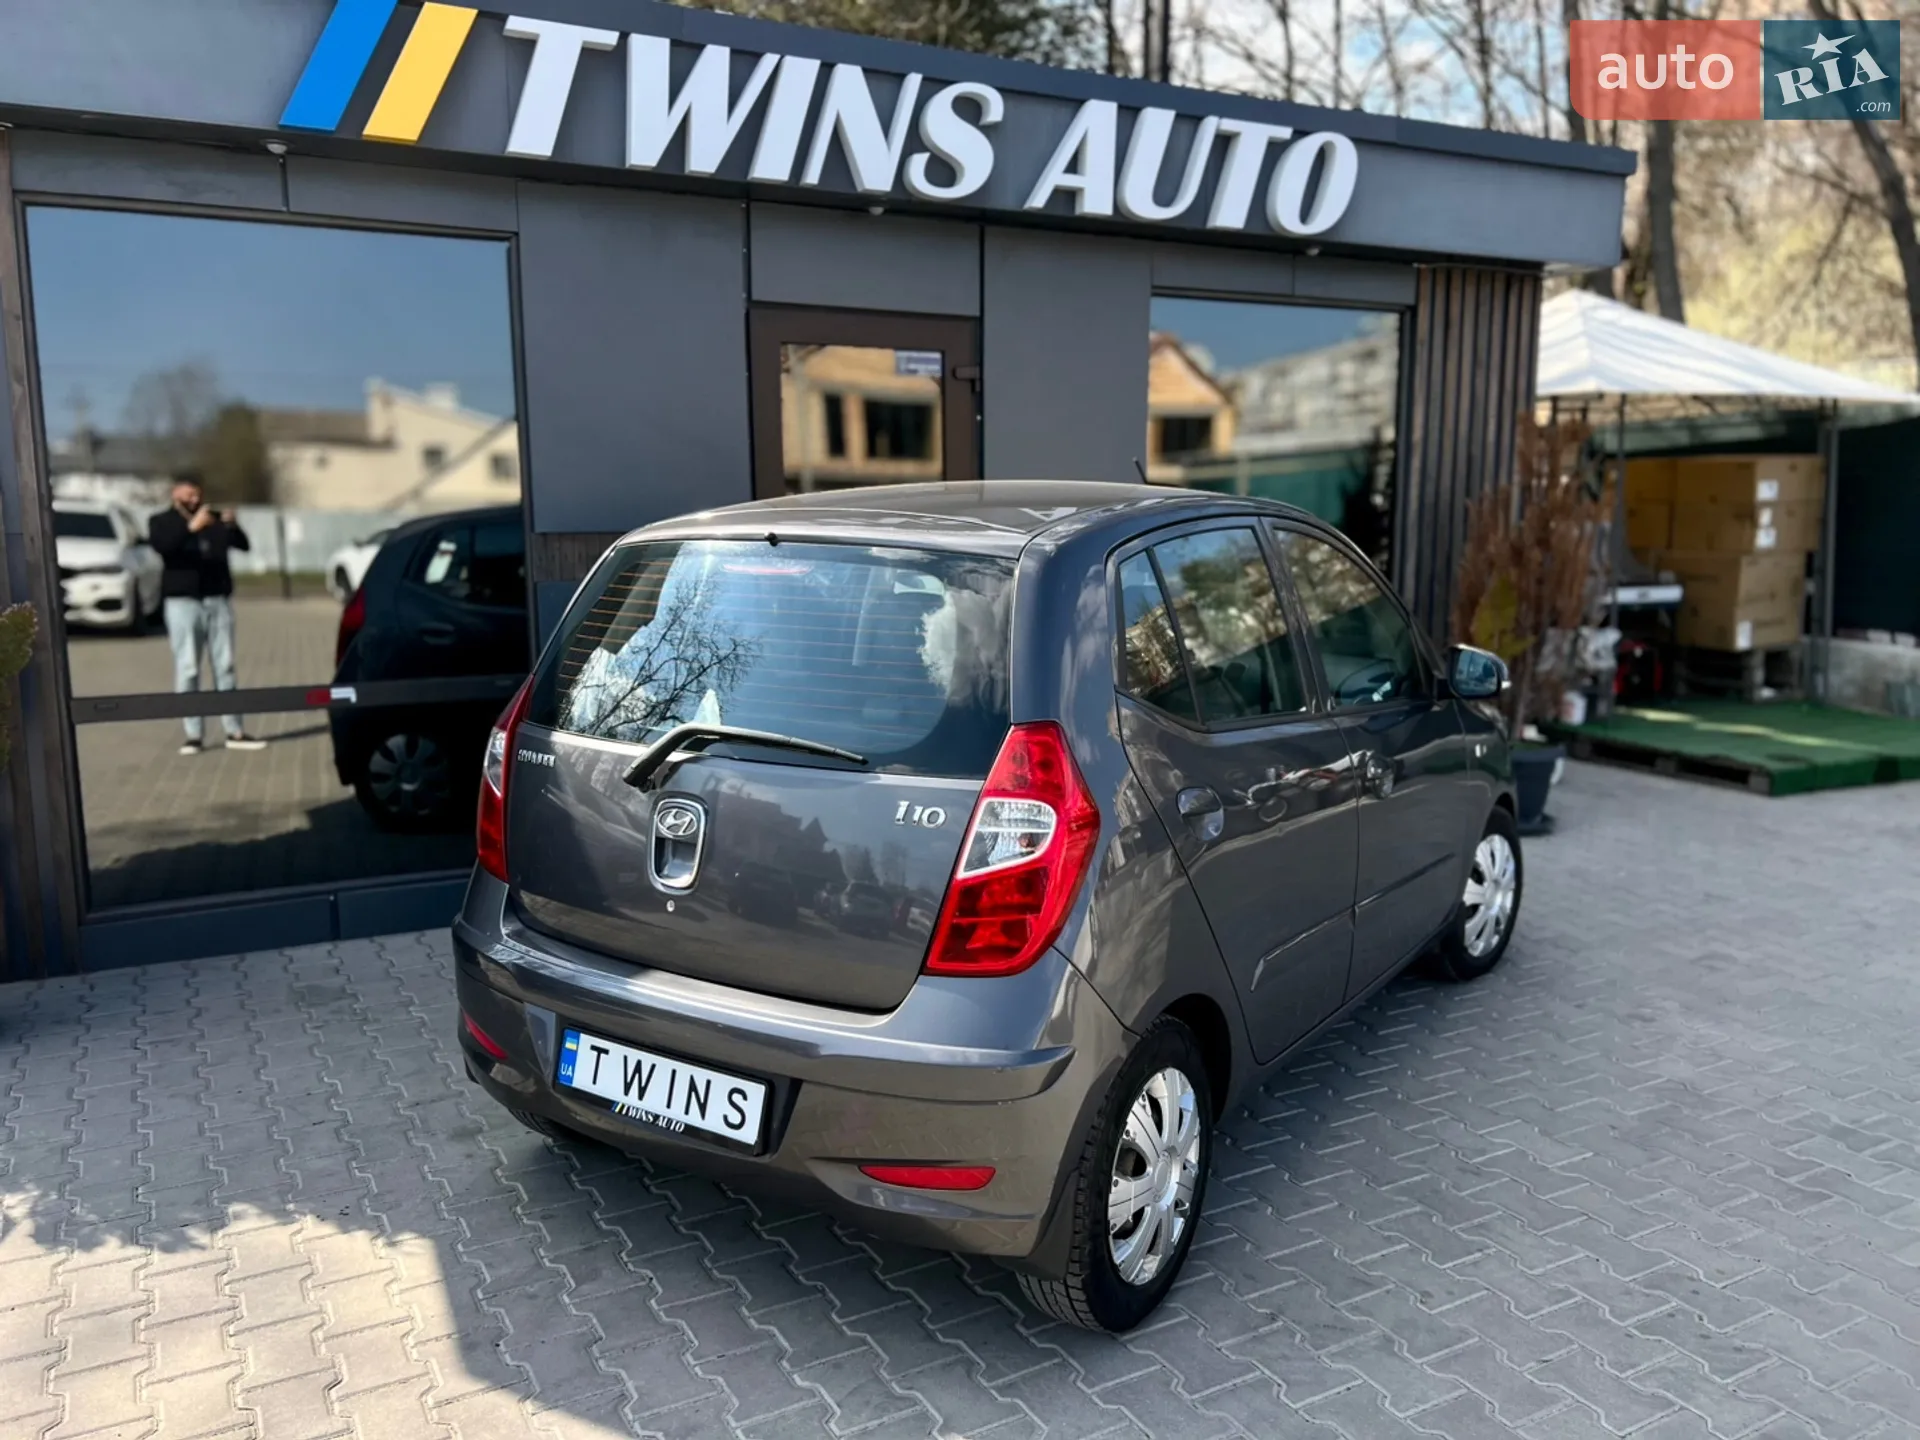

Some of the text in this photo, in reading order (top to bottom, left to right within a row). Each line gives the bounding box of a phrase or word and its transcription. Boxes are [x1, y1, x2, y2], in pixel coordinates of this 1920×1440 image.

[503, 15, 1359, 237] TWINS AUTO
[561, 1062, 573, 1077] UA
[590, 1044, 748, 1130] TWINS
[621, 1103, 686, 1133] TWINS AUTO
